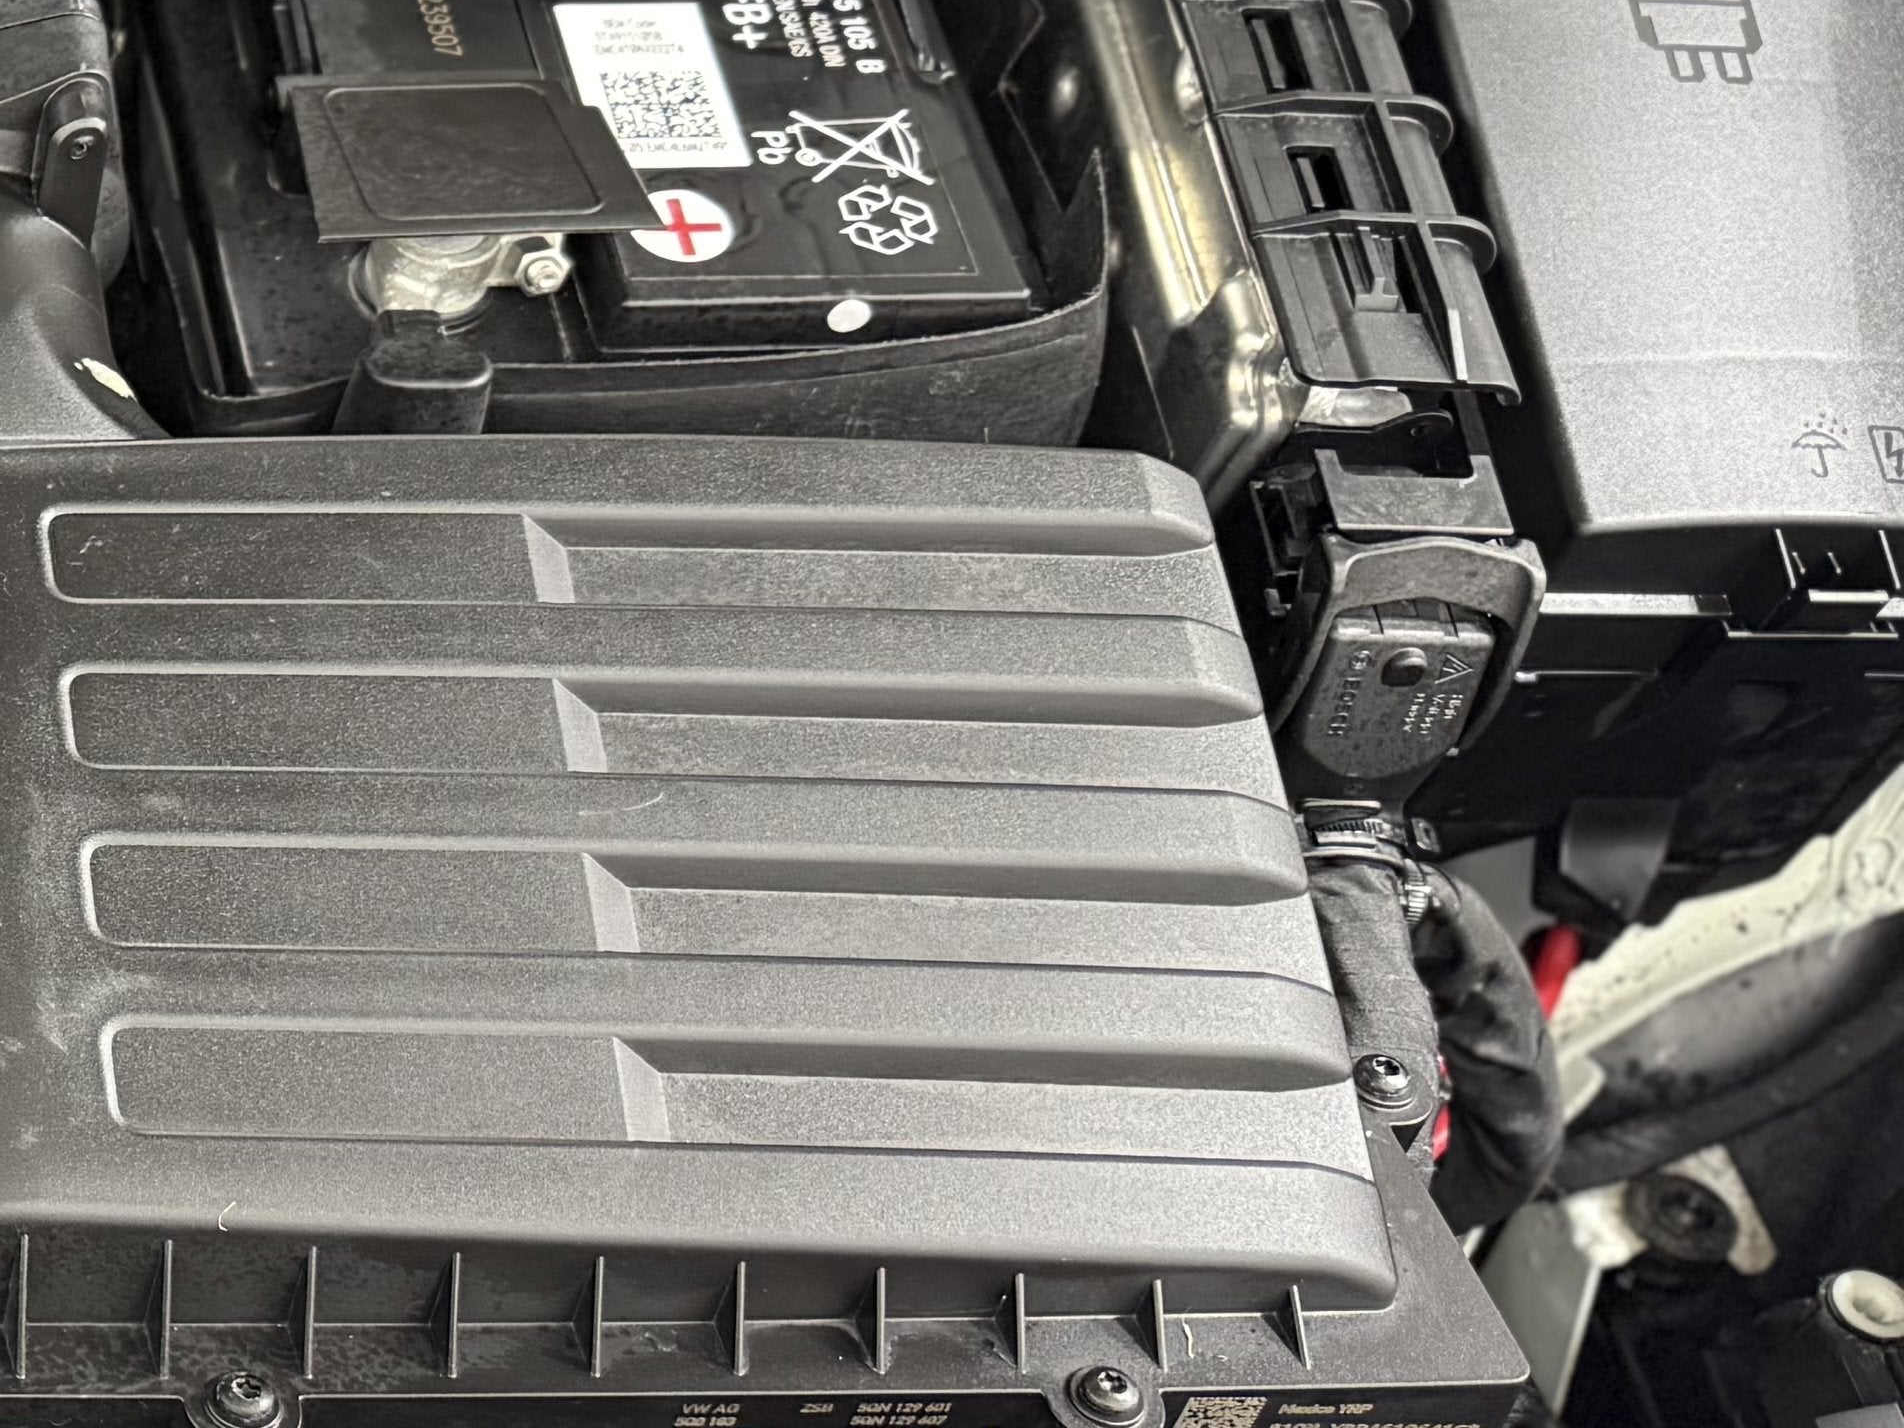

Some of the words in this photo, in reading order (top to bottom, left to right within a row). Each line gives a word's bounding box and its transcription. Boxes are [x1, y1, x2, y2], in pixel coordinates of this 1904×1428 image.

[840, 16, 877, 51] 105
[855, 58, 887, 74] B
[751, 130, 794, 165] Pb
[894, 1402, 923, 1413] 129
[888, 1415, 916, 1426] 129
